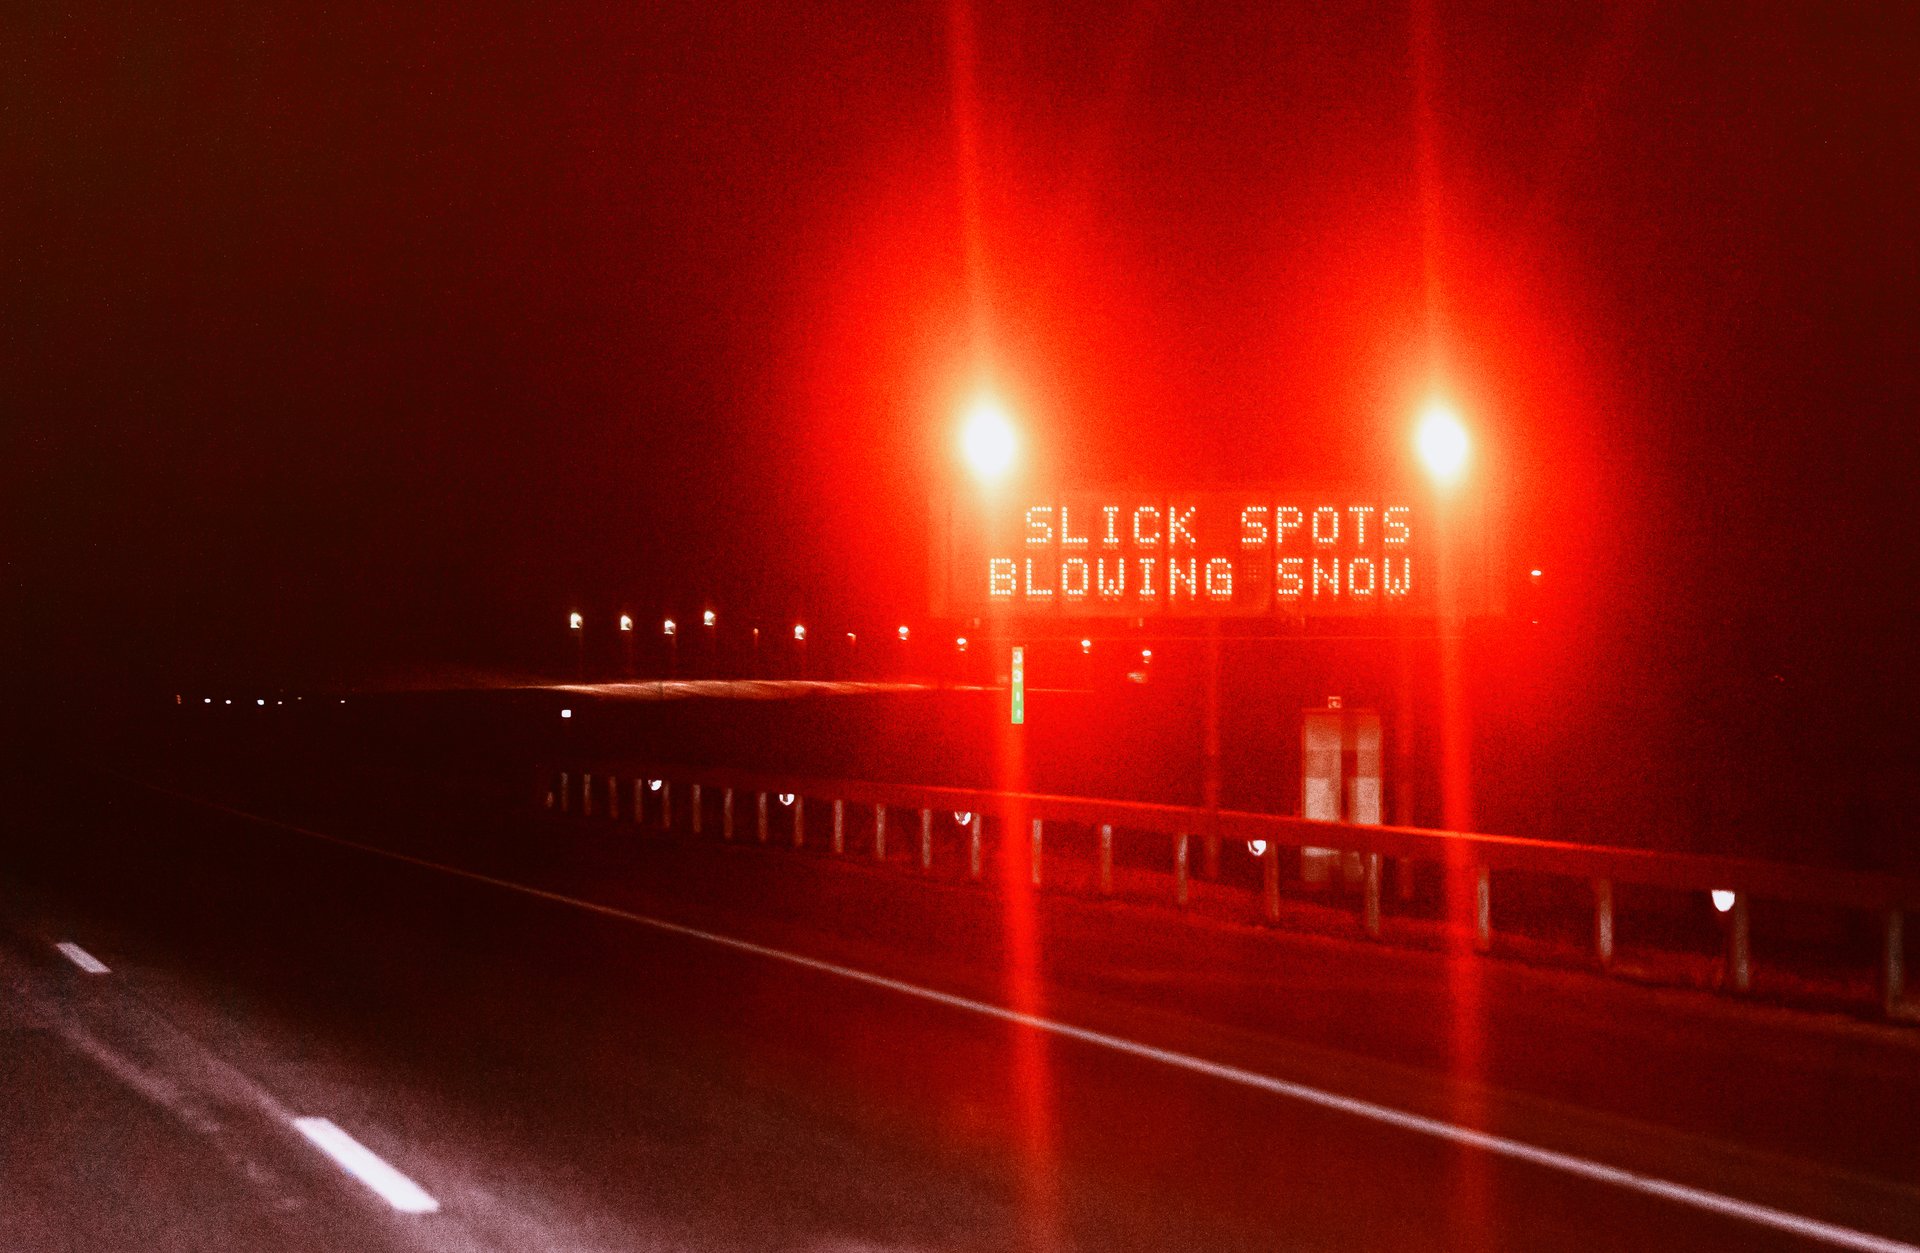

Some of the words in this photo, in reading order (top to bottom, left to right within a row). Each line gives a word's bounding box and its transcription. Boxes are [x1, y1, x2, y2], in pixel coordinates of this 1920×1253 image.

[1025, 506, 1197, 543] SLICK
[1241, 506, 1410, 543] SPOTS
[989, 557, 1233, 595] BLOWING
[1277, 557, 1410, 595] SNOW
